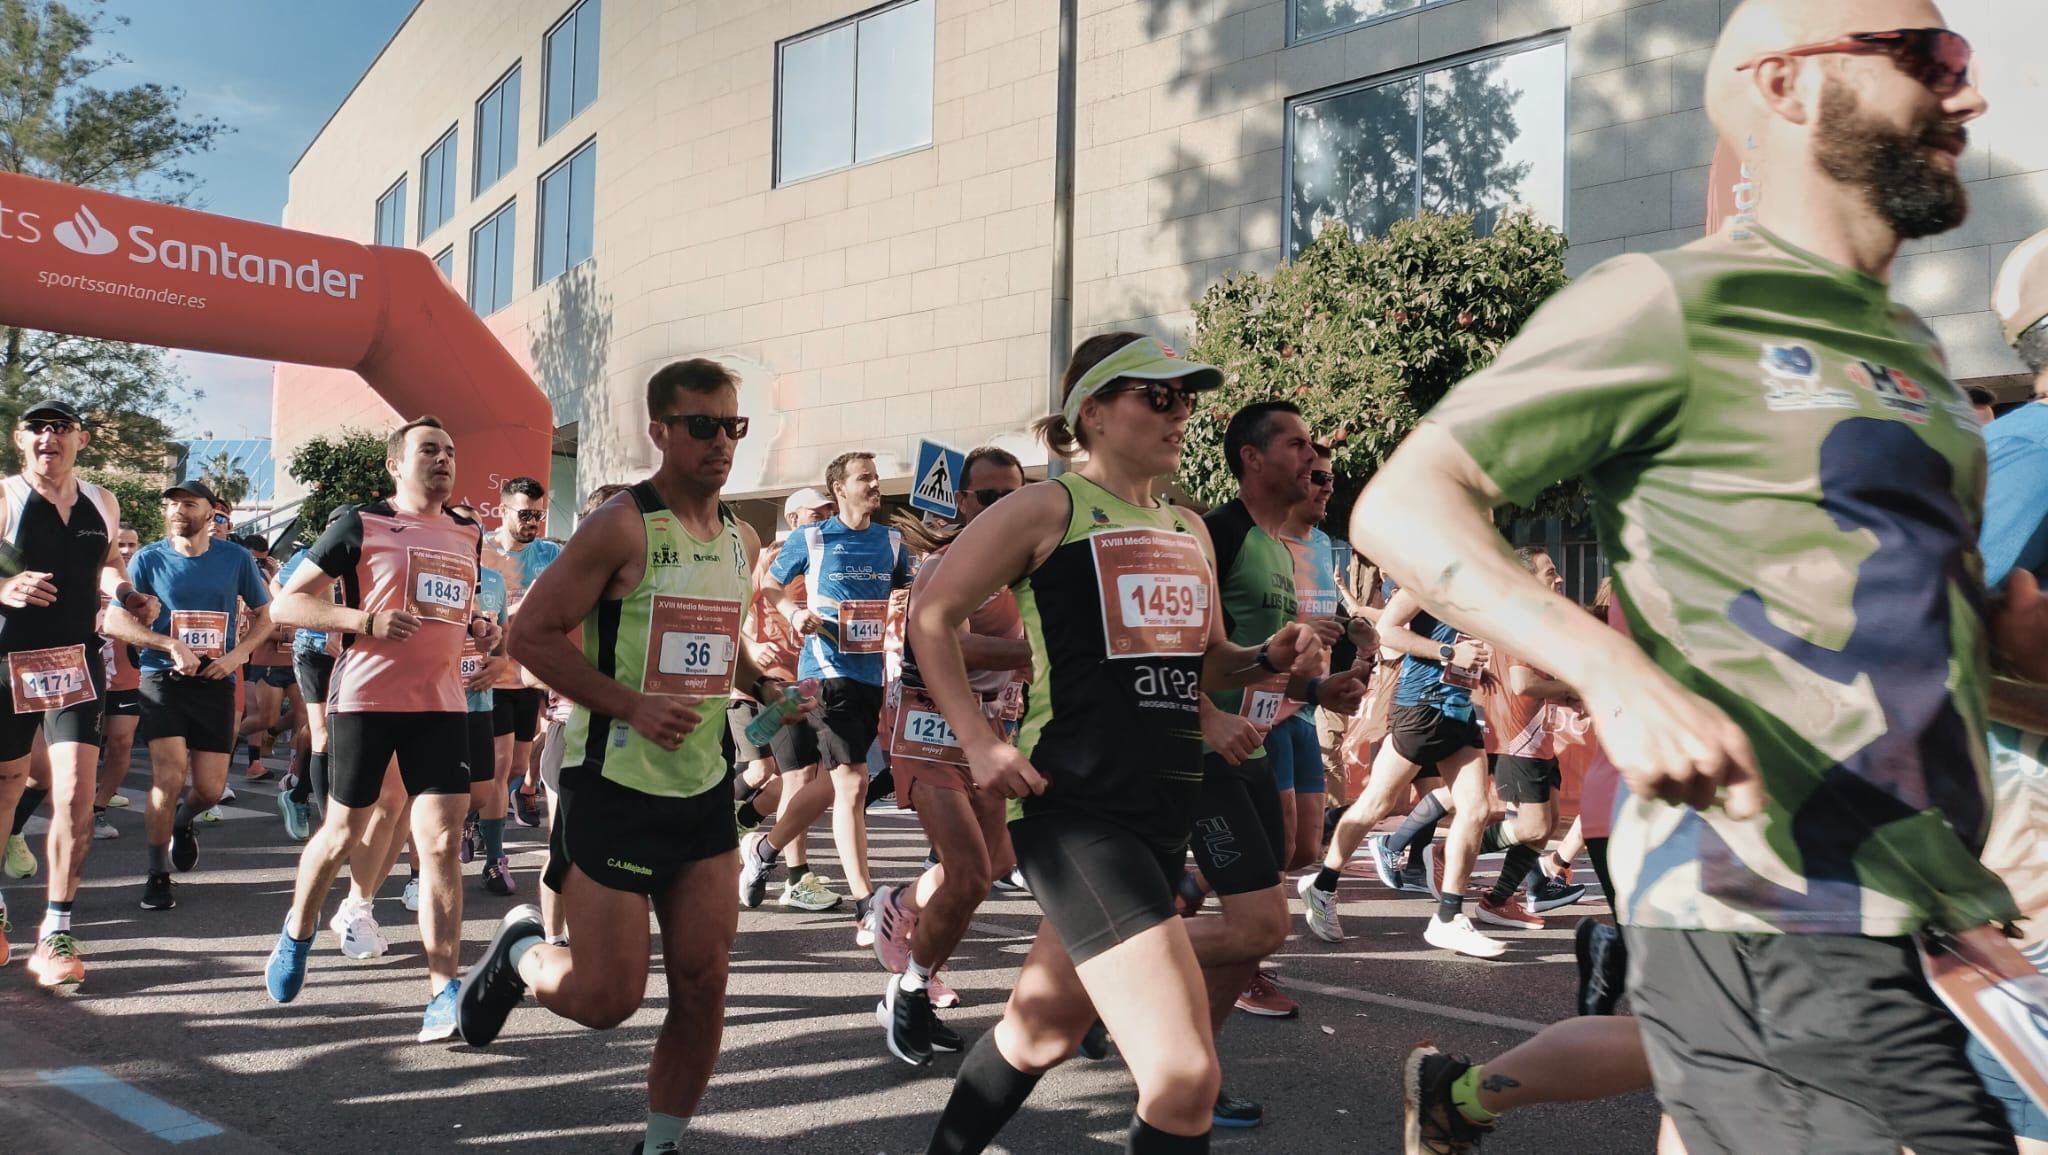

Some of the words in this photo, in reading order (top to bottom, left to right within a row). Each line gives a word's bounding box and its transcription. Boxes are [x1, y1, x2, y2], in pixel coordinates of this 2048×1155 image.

[128, 225, 363, 300] Santander
[38, 269, 206, 309] sportssantander.es
[1101, 538, 1123, 548] XVIII
[1124, 536, 1151, 546] Media
[845, 565, 873, 573] CLUB
[424, 579, 461, 602] 1843
[1131, 584, 1194, 616] 1459
[676, 602, 697, 611] Media
[182, 632, 216, 645] 1811
[851, 623, 879, 637] 1414
[684, 641, 711, 667] 36
[29, 673, 72, 693] 1171
[1134, 665, 1199, 701] area
[1195, 815, 1242, 869] FILA
